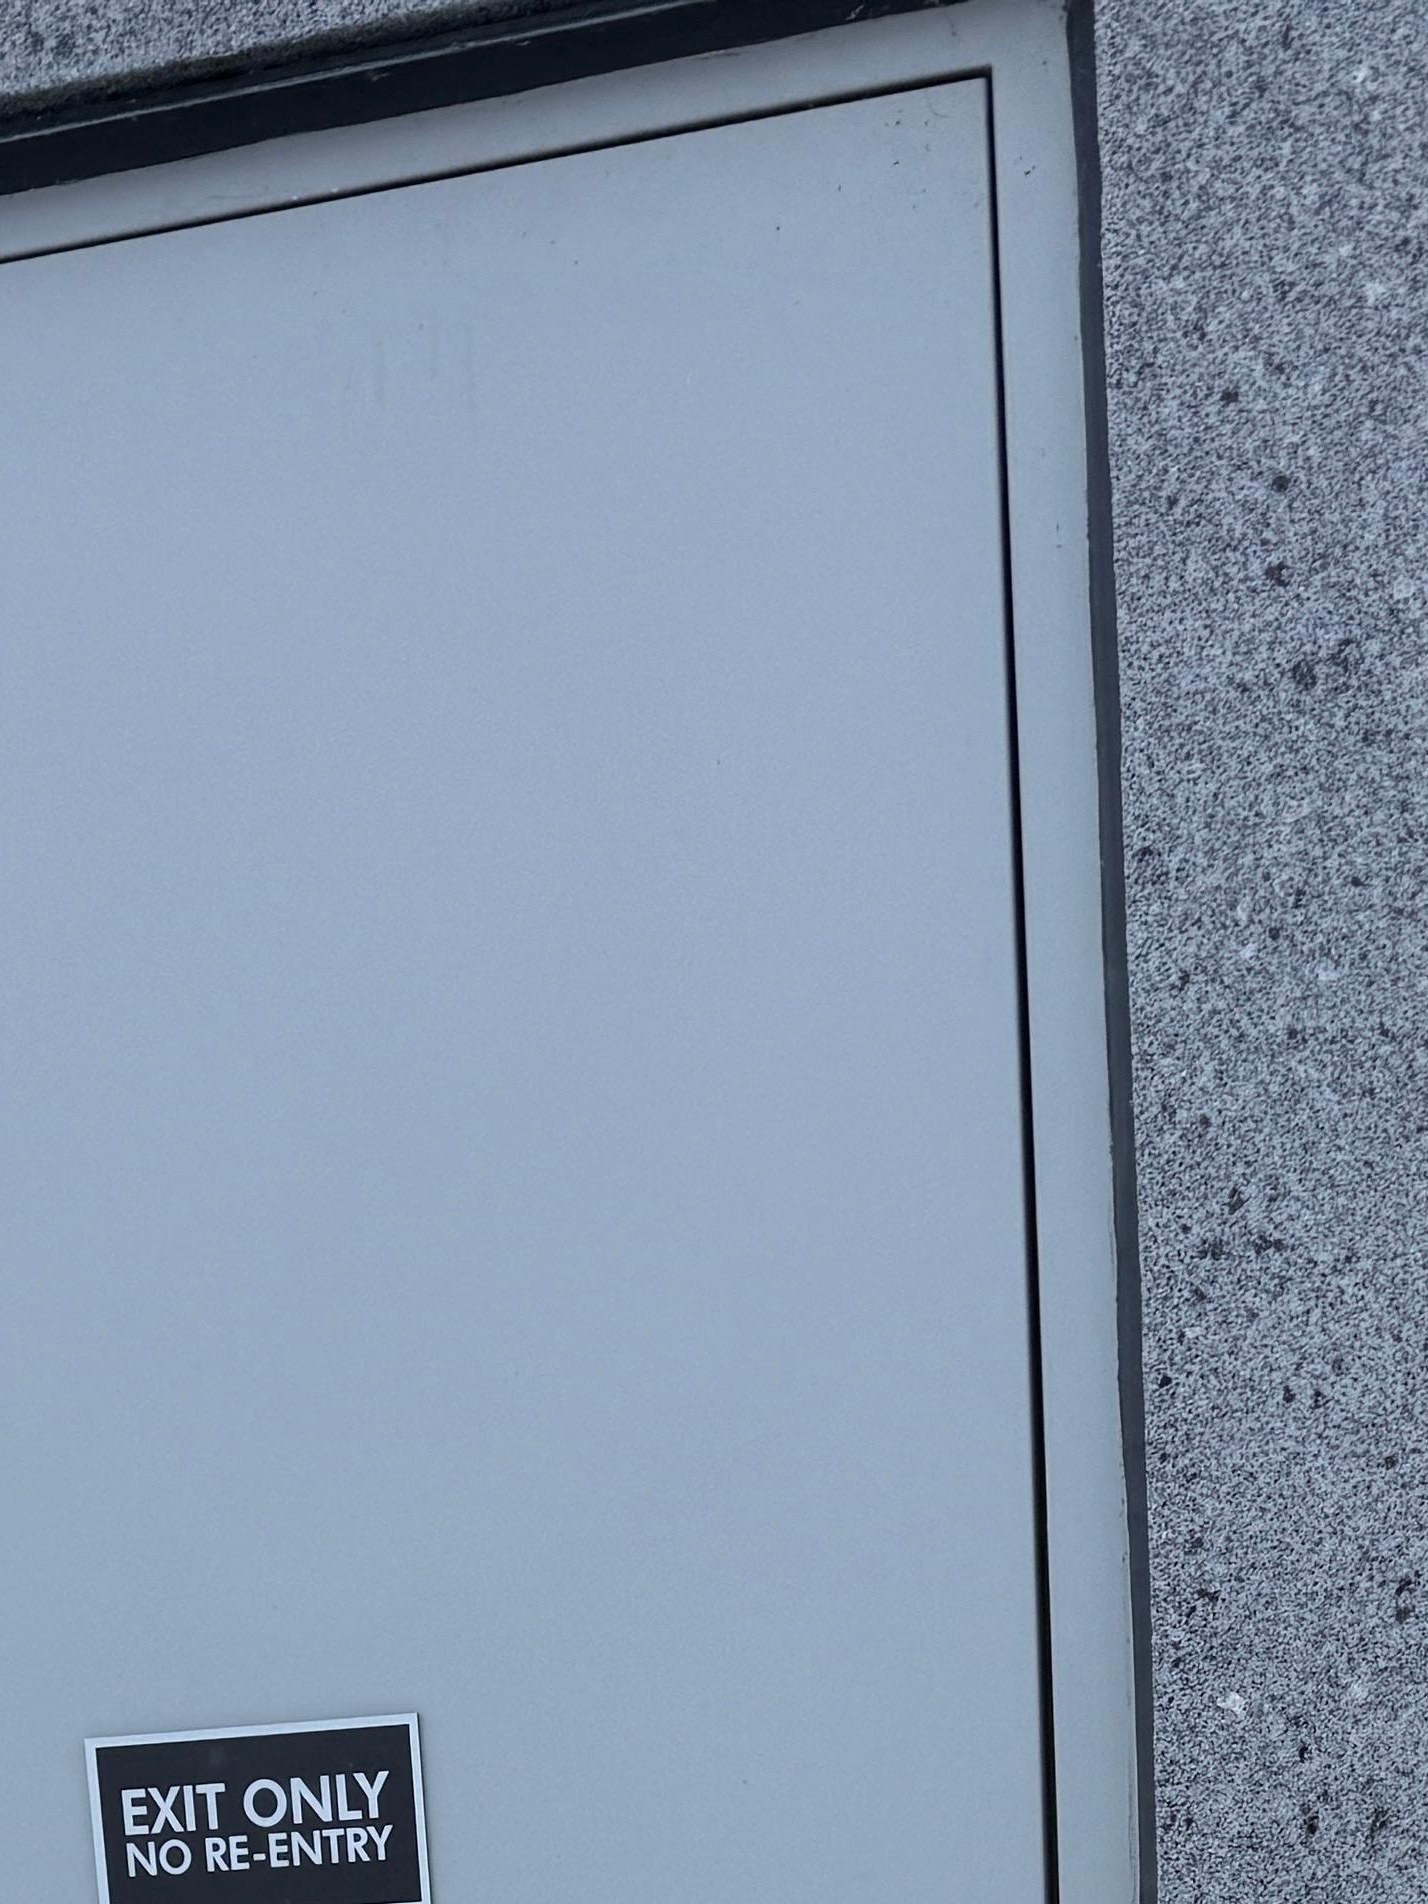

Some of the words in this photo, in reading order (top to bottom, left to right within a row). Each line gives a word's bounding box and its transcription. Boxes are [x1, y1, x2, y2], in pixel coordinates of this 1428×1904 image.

[121, 1782, 226, 1836] EXIT
[243, 1770, 390, 1828] ONLY
[126, 1839, 192, 1878] NO
[205, 1824, 394, 1873] RE-ENTRY
